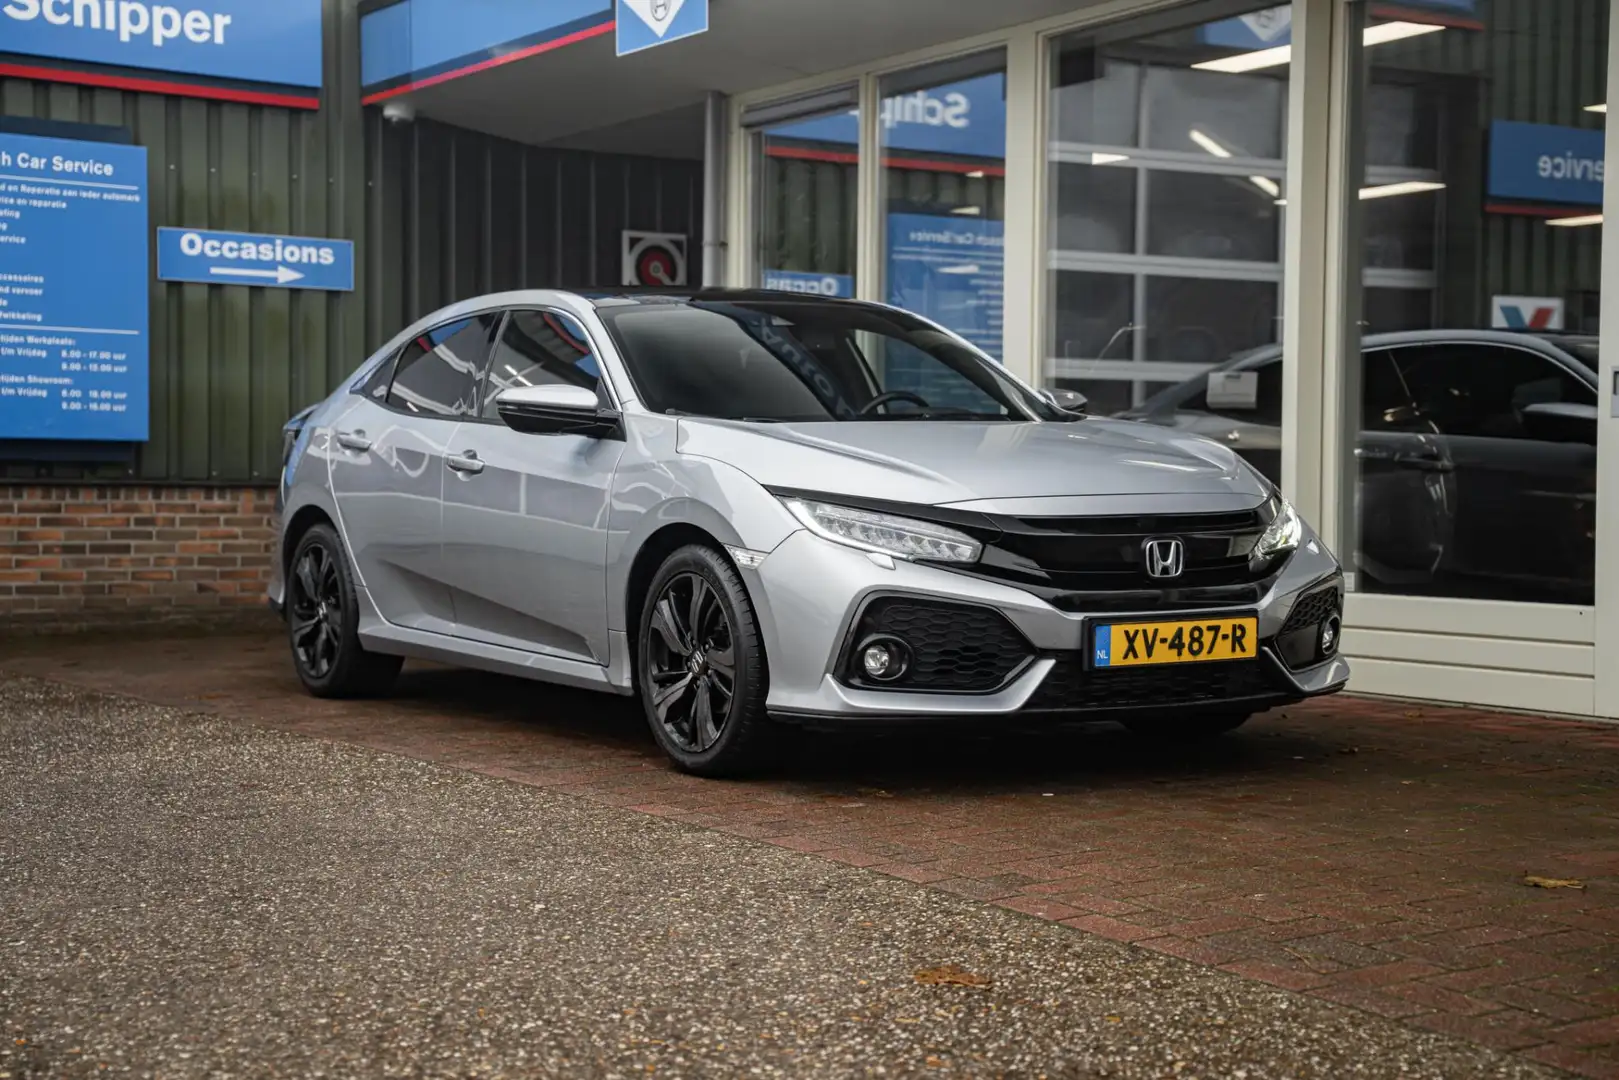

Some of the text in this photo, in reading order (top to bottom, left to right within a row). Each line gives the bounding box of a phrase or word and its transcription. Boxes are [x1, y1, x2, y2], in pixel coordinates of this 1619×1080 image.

[17, 152, 47, 169] Car
[52, 155, 114, 176] Service
[180, 232, 335, 265] Occasions
[17, 347, 47, 358] Vrijdag
[17, 387, 47, 398] Vrijdag
[1096, 624, 1247, 661] NL XV-487-R
